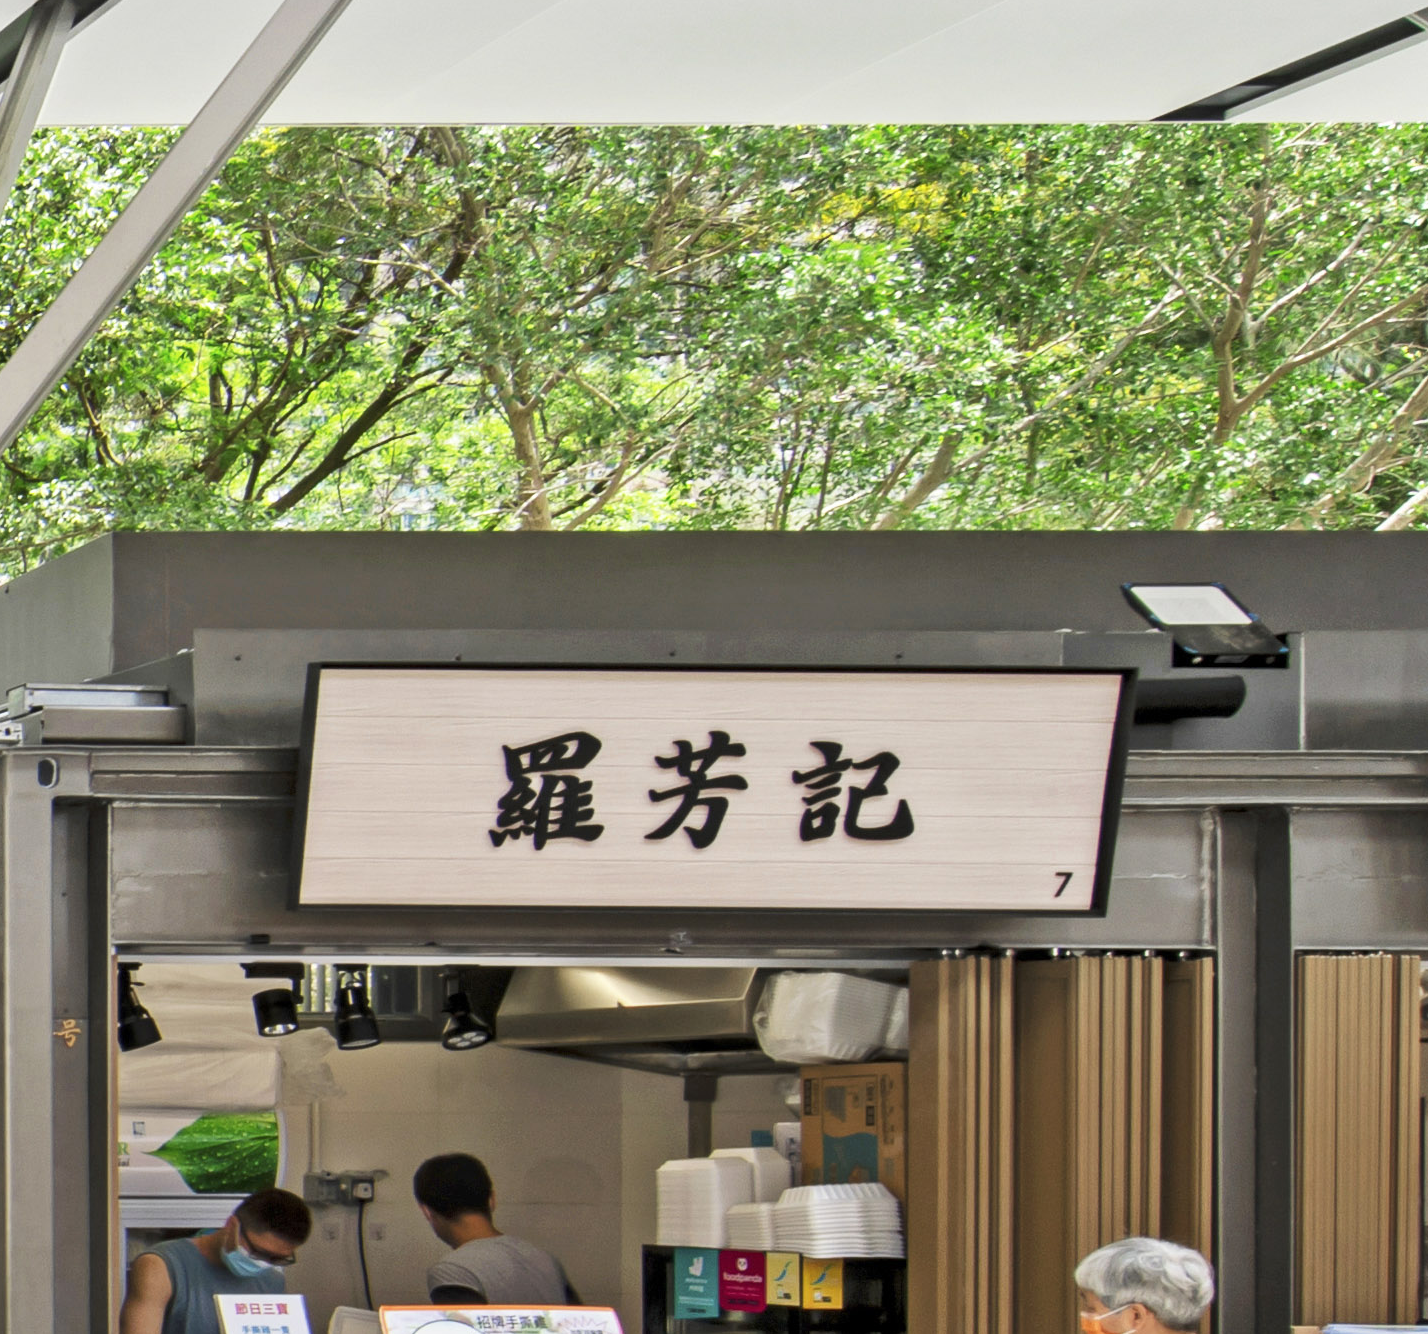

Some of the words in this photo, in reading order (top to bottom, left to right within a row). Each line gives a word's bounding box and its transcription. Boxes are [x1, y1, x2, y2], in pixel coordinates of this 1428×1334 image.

[488, 730, 915, 851] 羅芳記
[1053, 872, 1073, 898] 7
[723, 1272, 762, 1283] foodpanda
